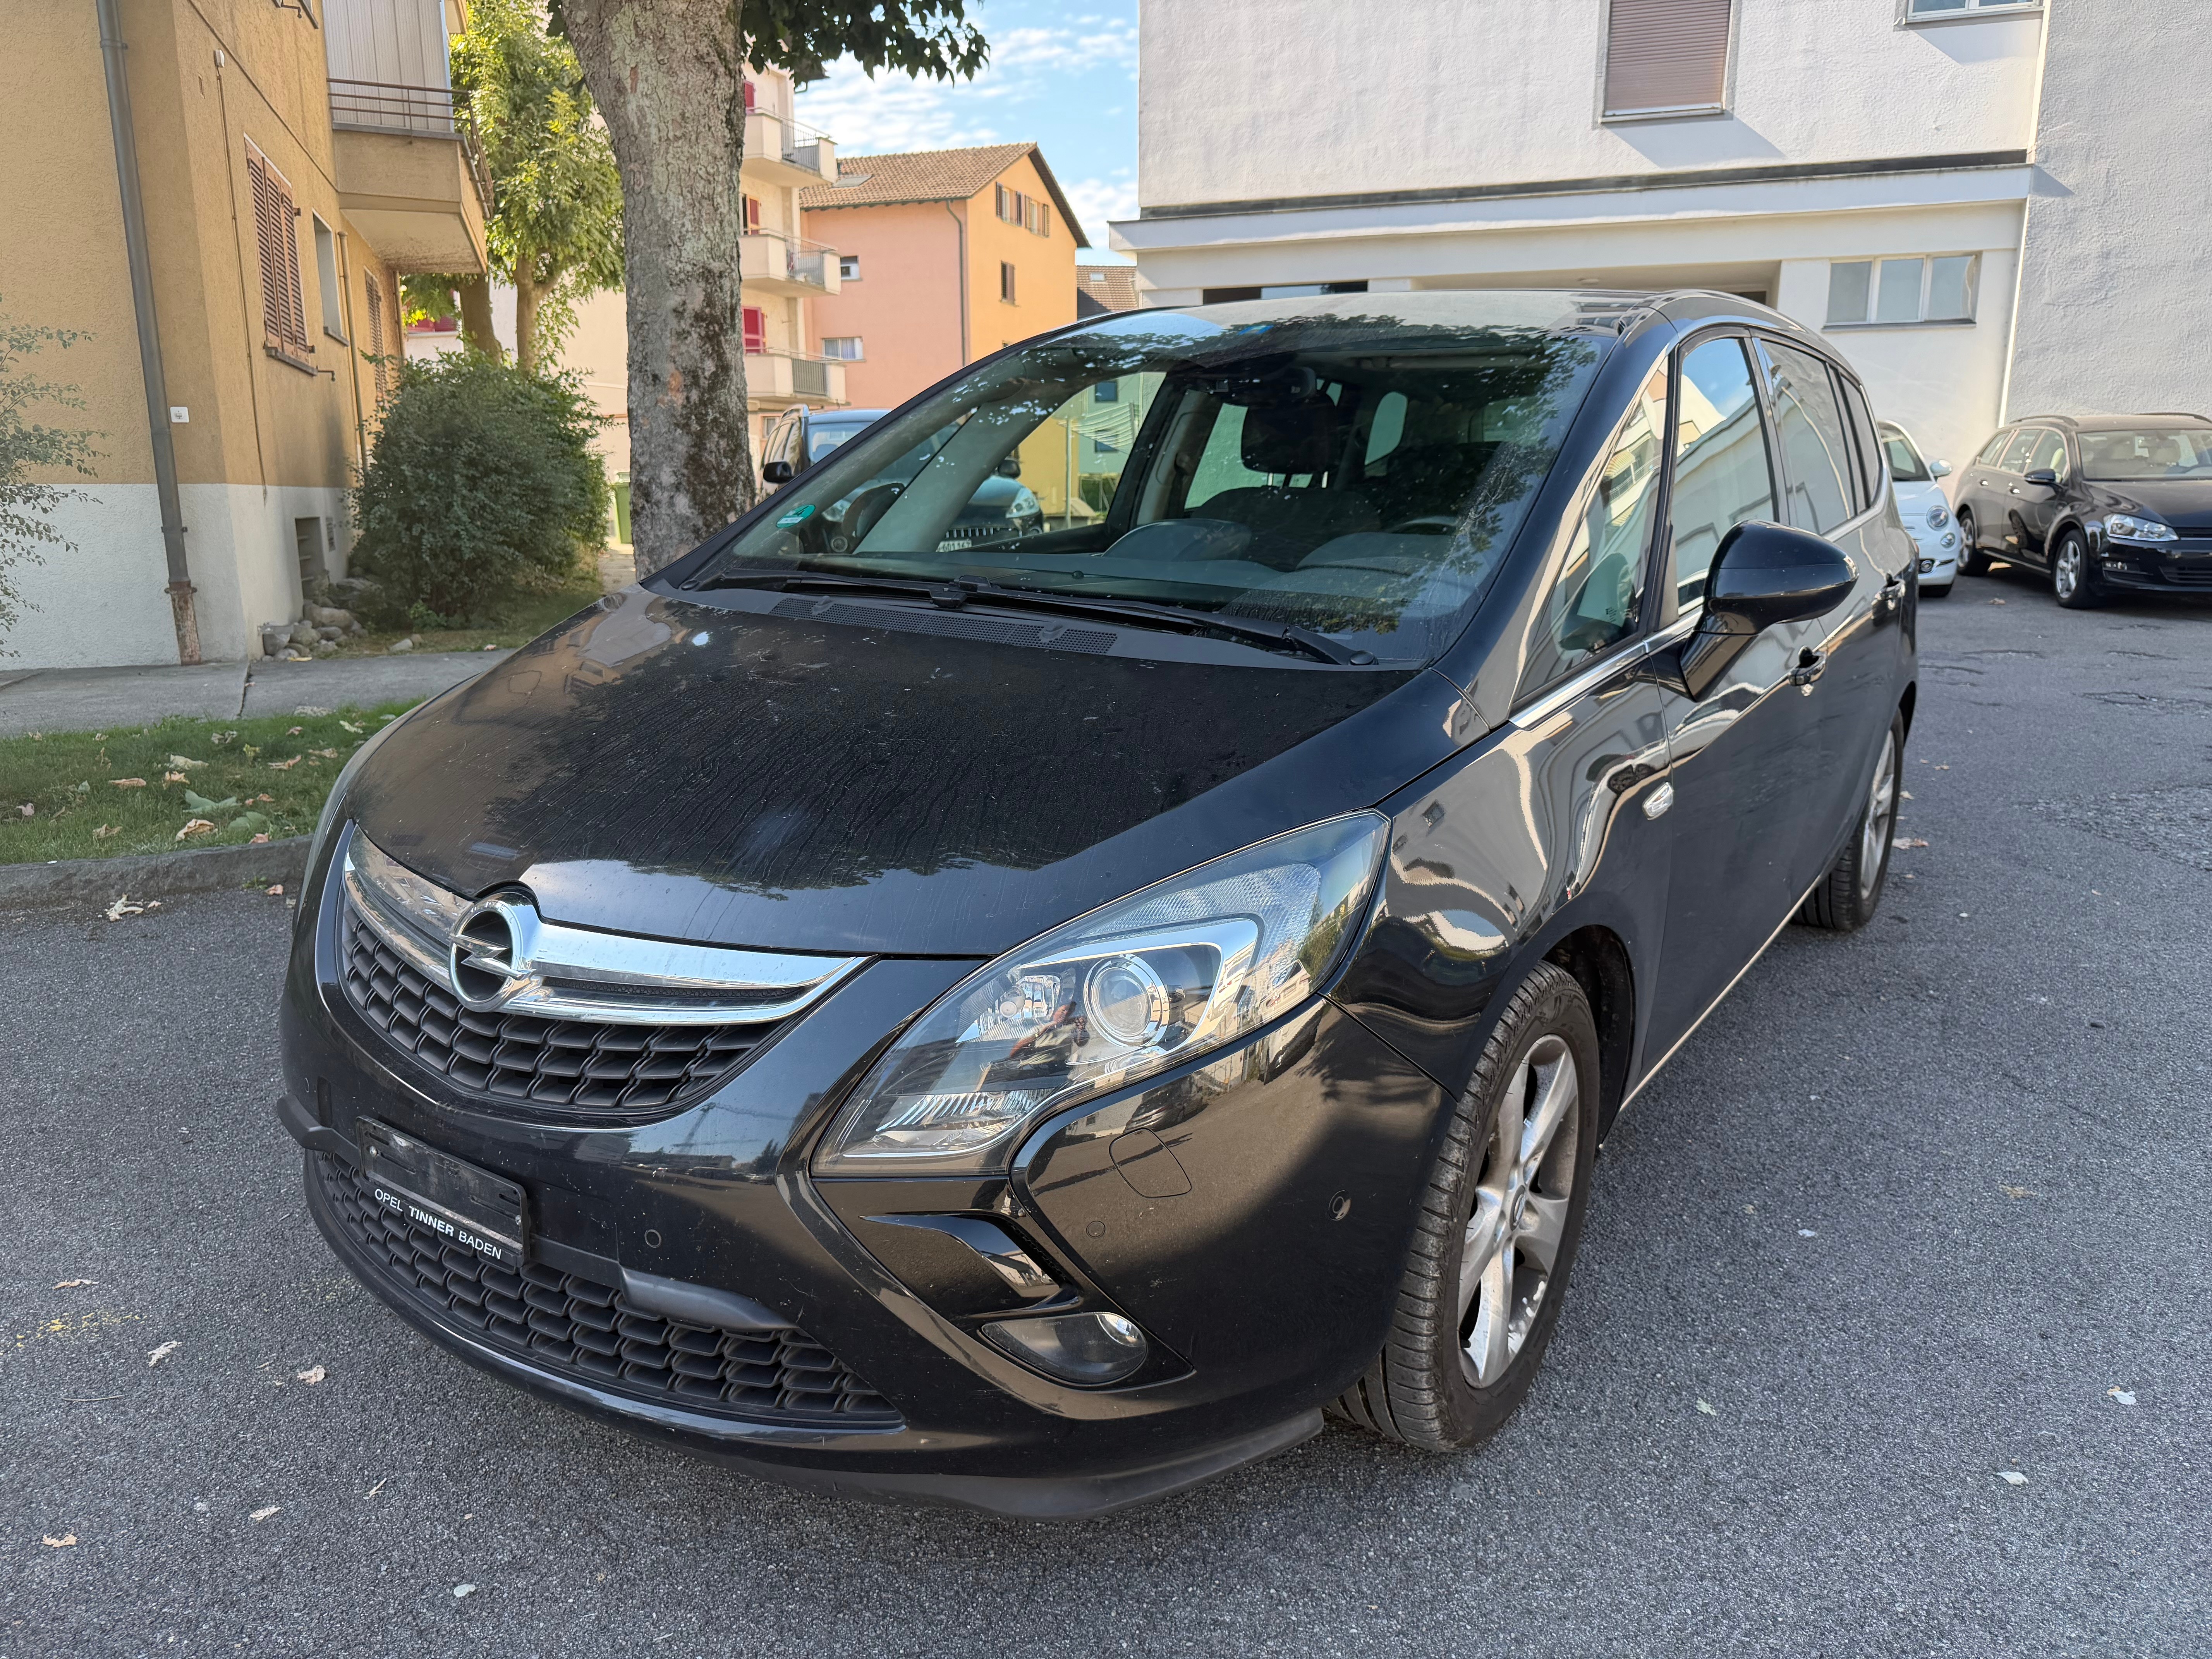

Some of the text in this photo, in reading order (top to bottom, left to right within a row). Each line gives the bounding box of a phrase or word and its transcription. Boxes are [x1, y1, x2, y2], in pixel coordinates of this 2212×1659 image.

[374, 1188, 502, 1260] OPEL TINNER BADEN
